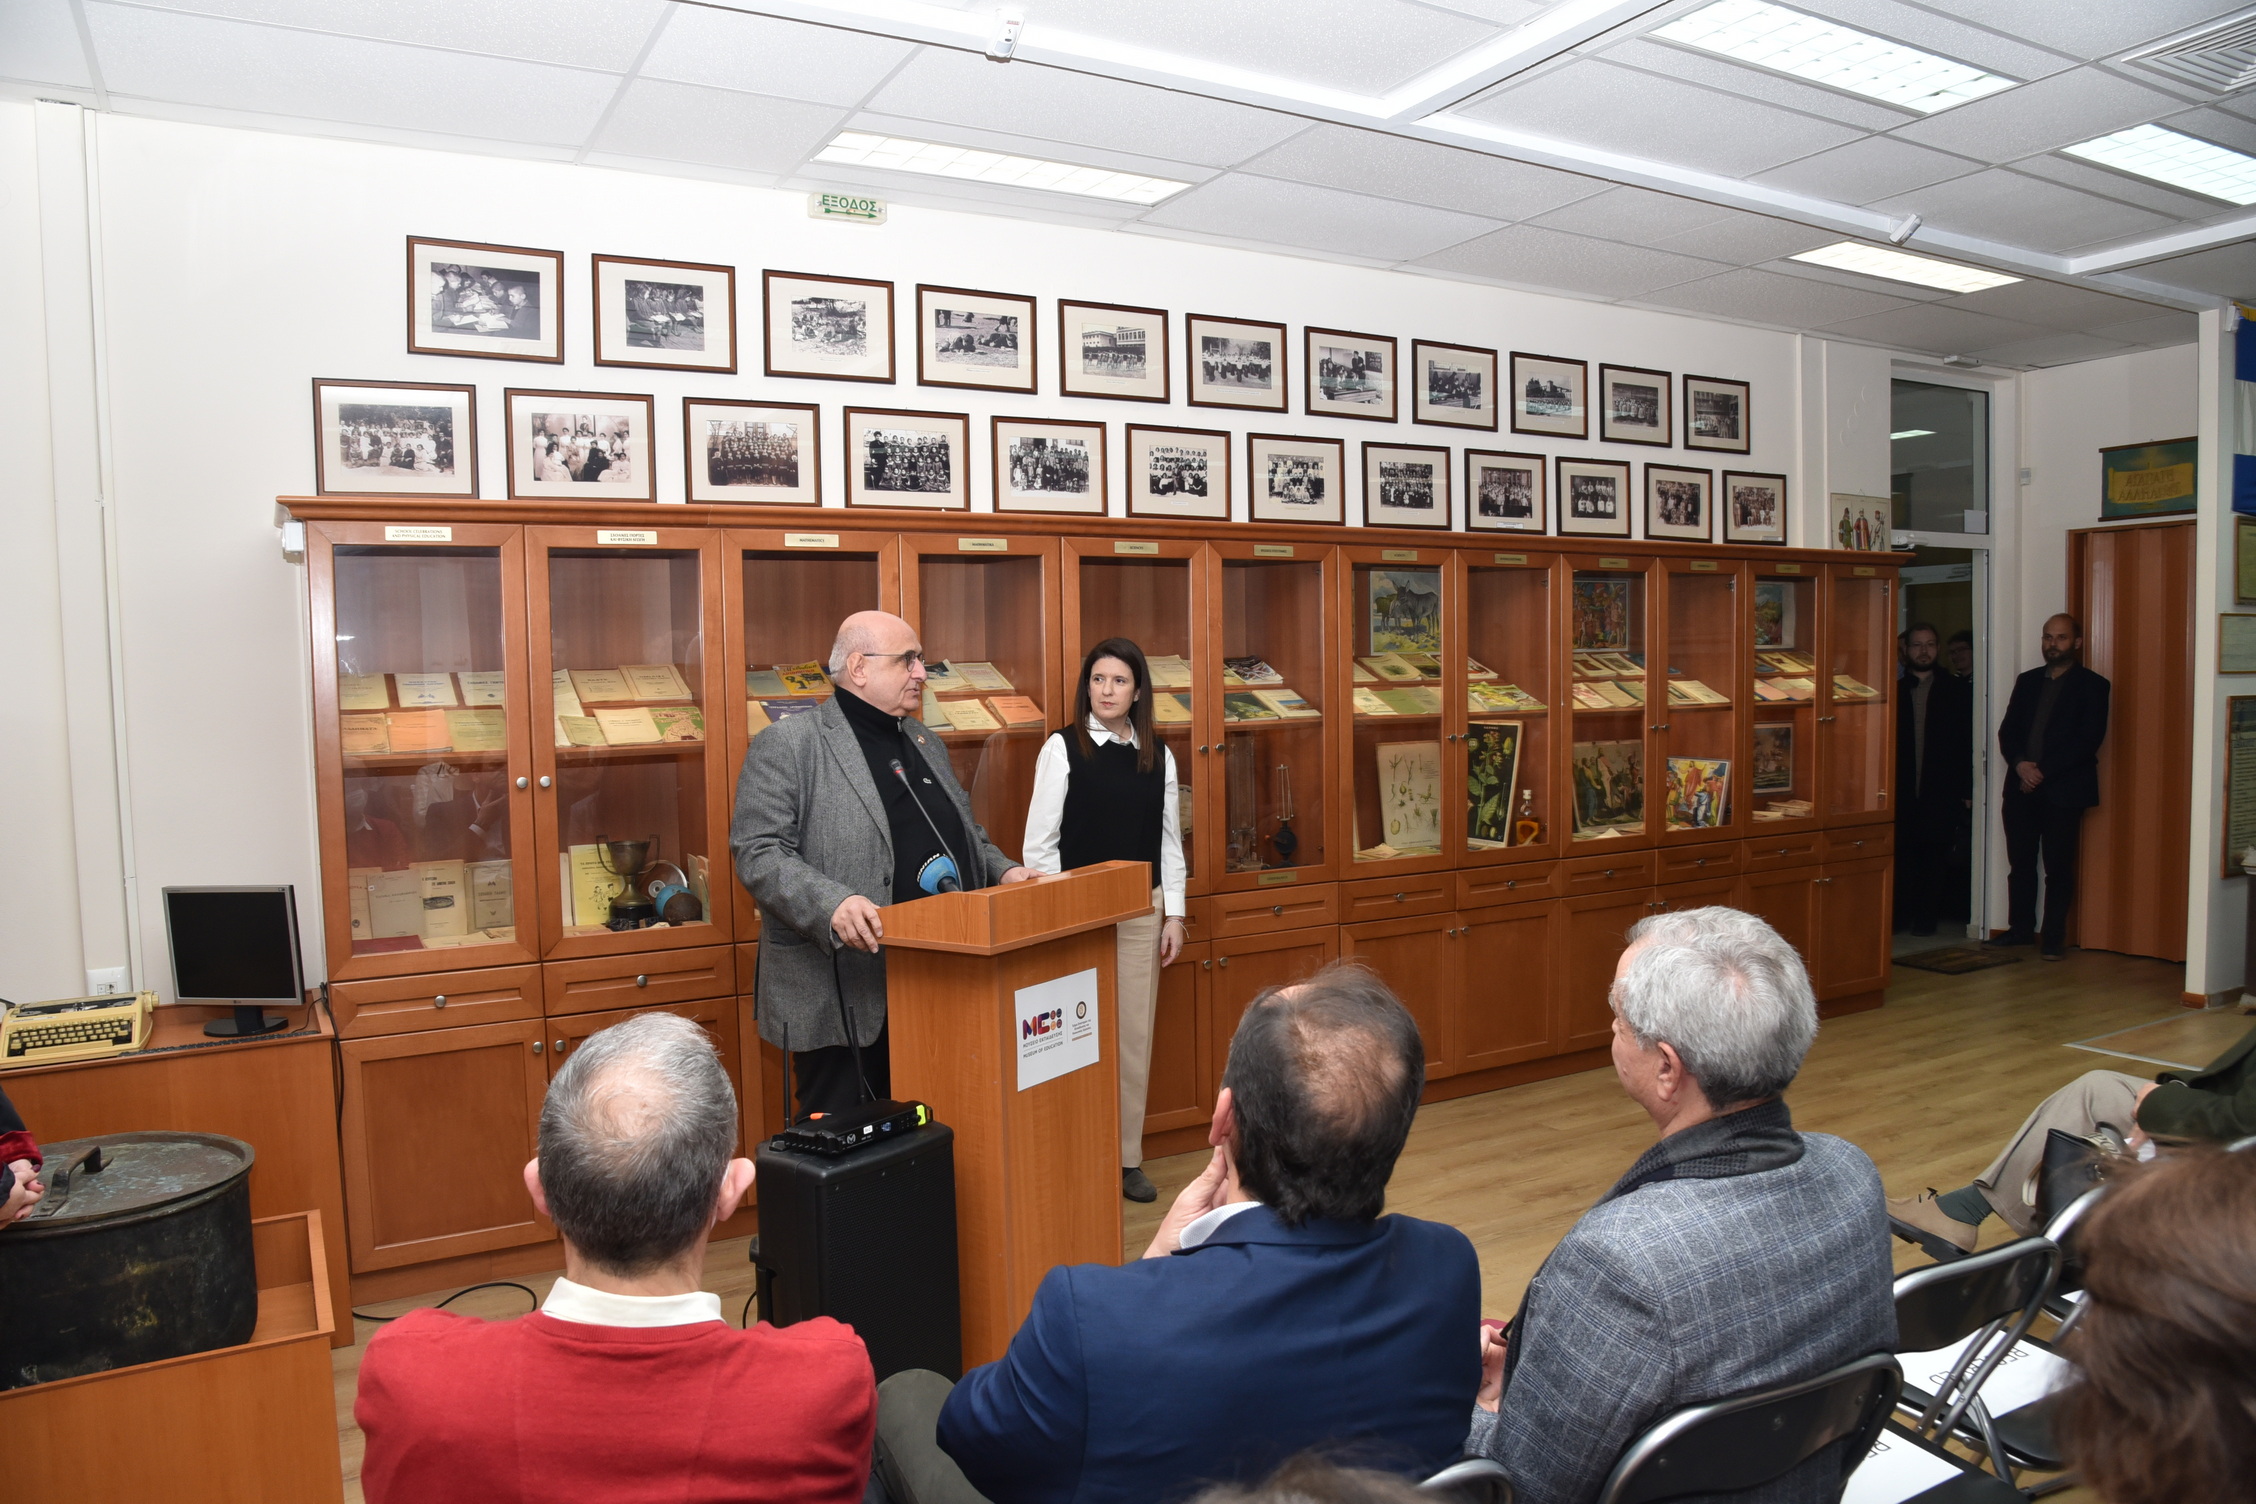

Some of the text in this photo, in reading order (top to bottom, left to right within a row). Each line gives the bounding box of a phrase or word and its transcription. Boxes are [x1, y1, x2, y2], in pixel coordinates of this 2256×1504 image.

[822, 194, 877, 212] ΕΞΟΔΟΣ
[1022, 1031, 1063, 1048] ΜΟΥΣΕΙΟ ΕΚΠΑΙΔΕΥΣΗΣ
[1023, 1049, 1038, 1058] MUSEUM
[1044, 1041, 1064, 1052] EDUCATION
